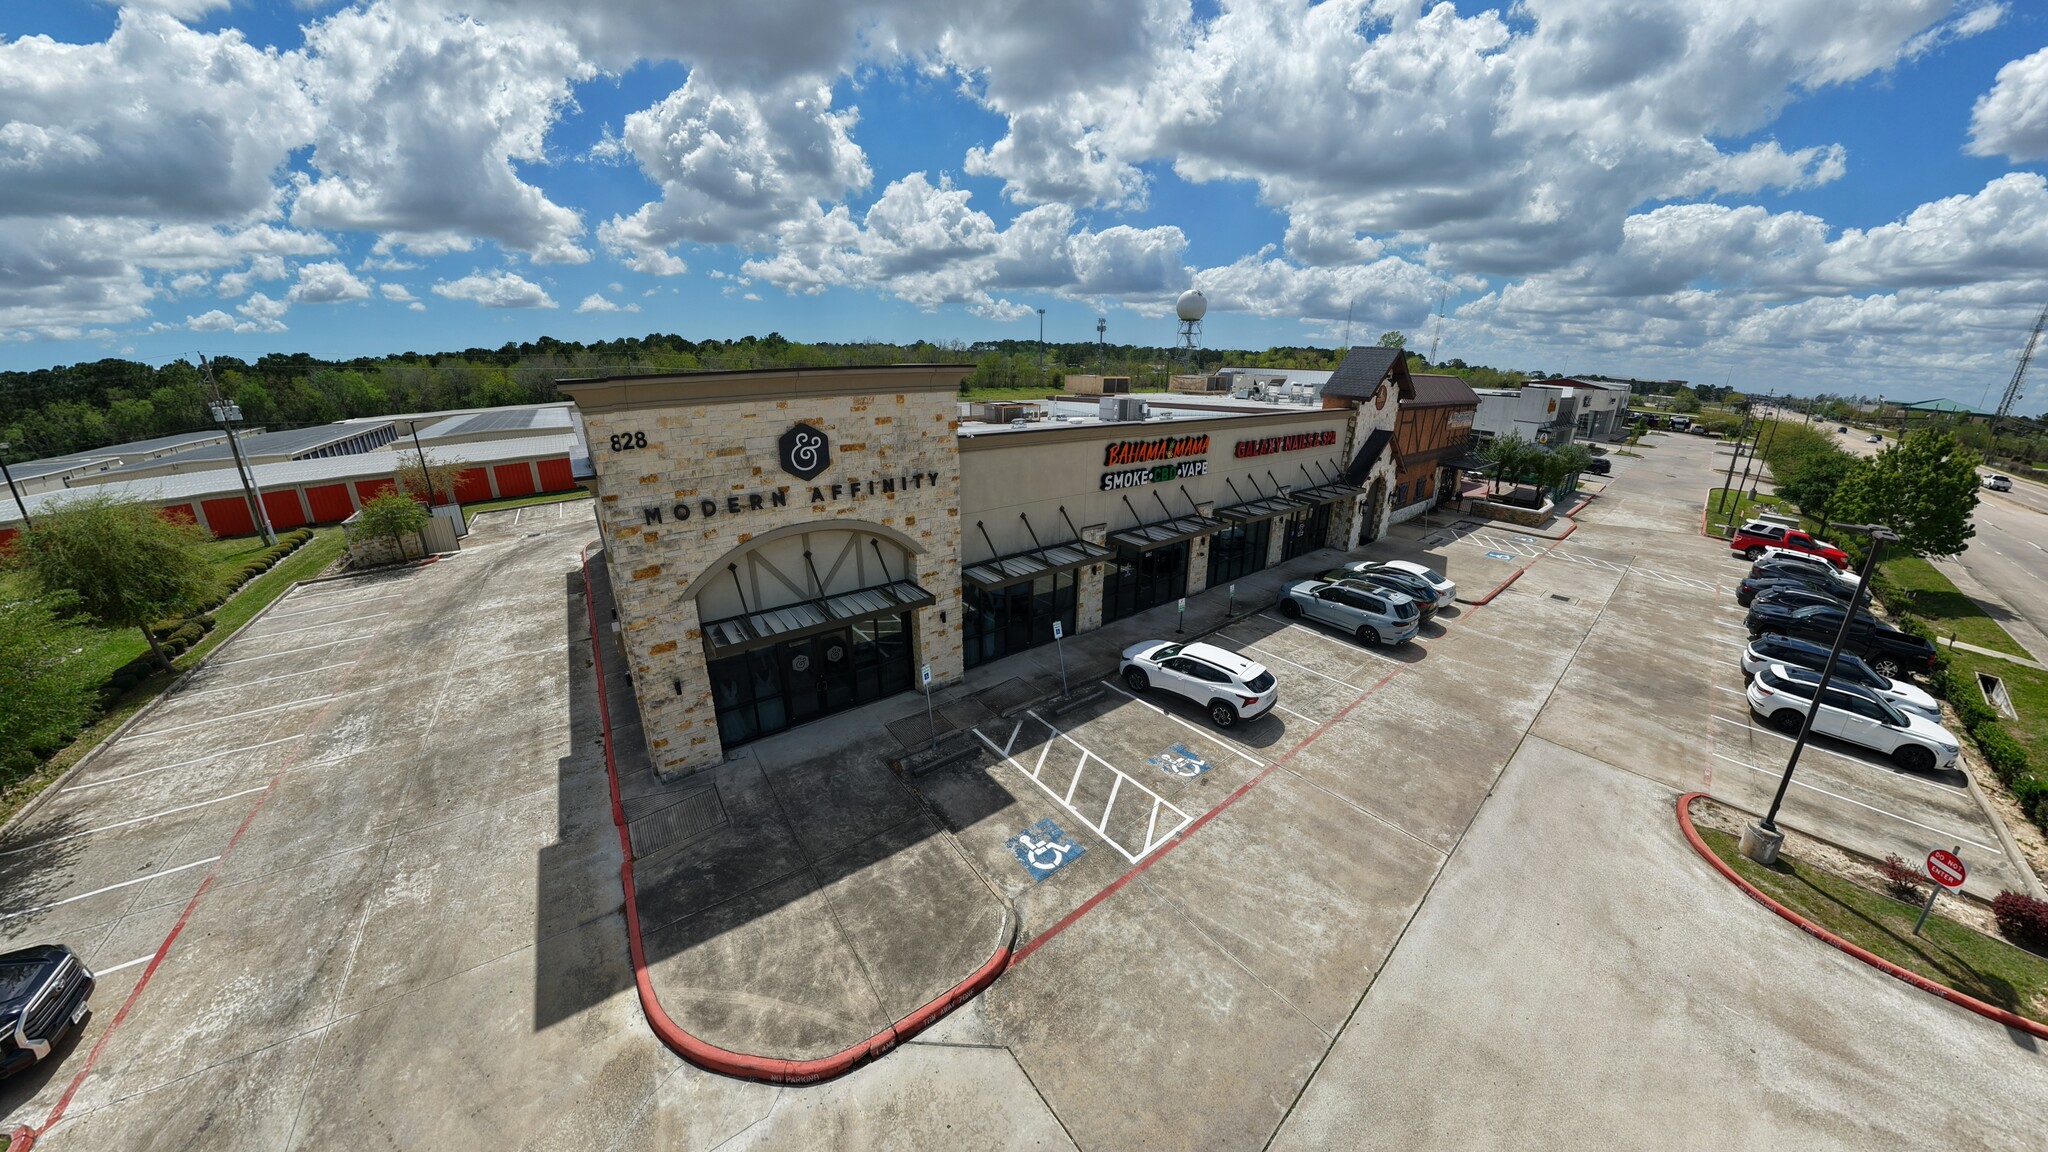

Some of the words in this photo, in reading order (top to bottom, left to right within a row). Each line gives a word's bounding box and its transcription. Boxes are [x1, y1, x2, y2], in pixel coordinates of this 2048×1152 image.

[610, 431, 648, 452] 828
[1107, 440, 1168, 467] BAHAMA
[1173, 436, 1211, 459] MAMA
[1235, 436, 1283, 458] GALAXY
[1283, 433, 1313, 451] NAILS
[1313, 432, 1320, 447] &
[1321, 430, 1337, 446] SPA
[1104, 470, 1149, 491] SMOKE
[1153, 466, 1177, 483] CBD
[1182, 461, 1209, 478] VAPE
[644, 491, 787, 526] MODERN
[811, 472, 939, 503] AFFINITY
[1934, 851, 1945, 861] DO
[1947, 860, 1963, 872] NOT
[1931, 865, 1955, 883] ENTER
[770, 1074, 782, 1083] NO
[785, 1073, 820, 1083] PARKING
